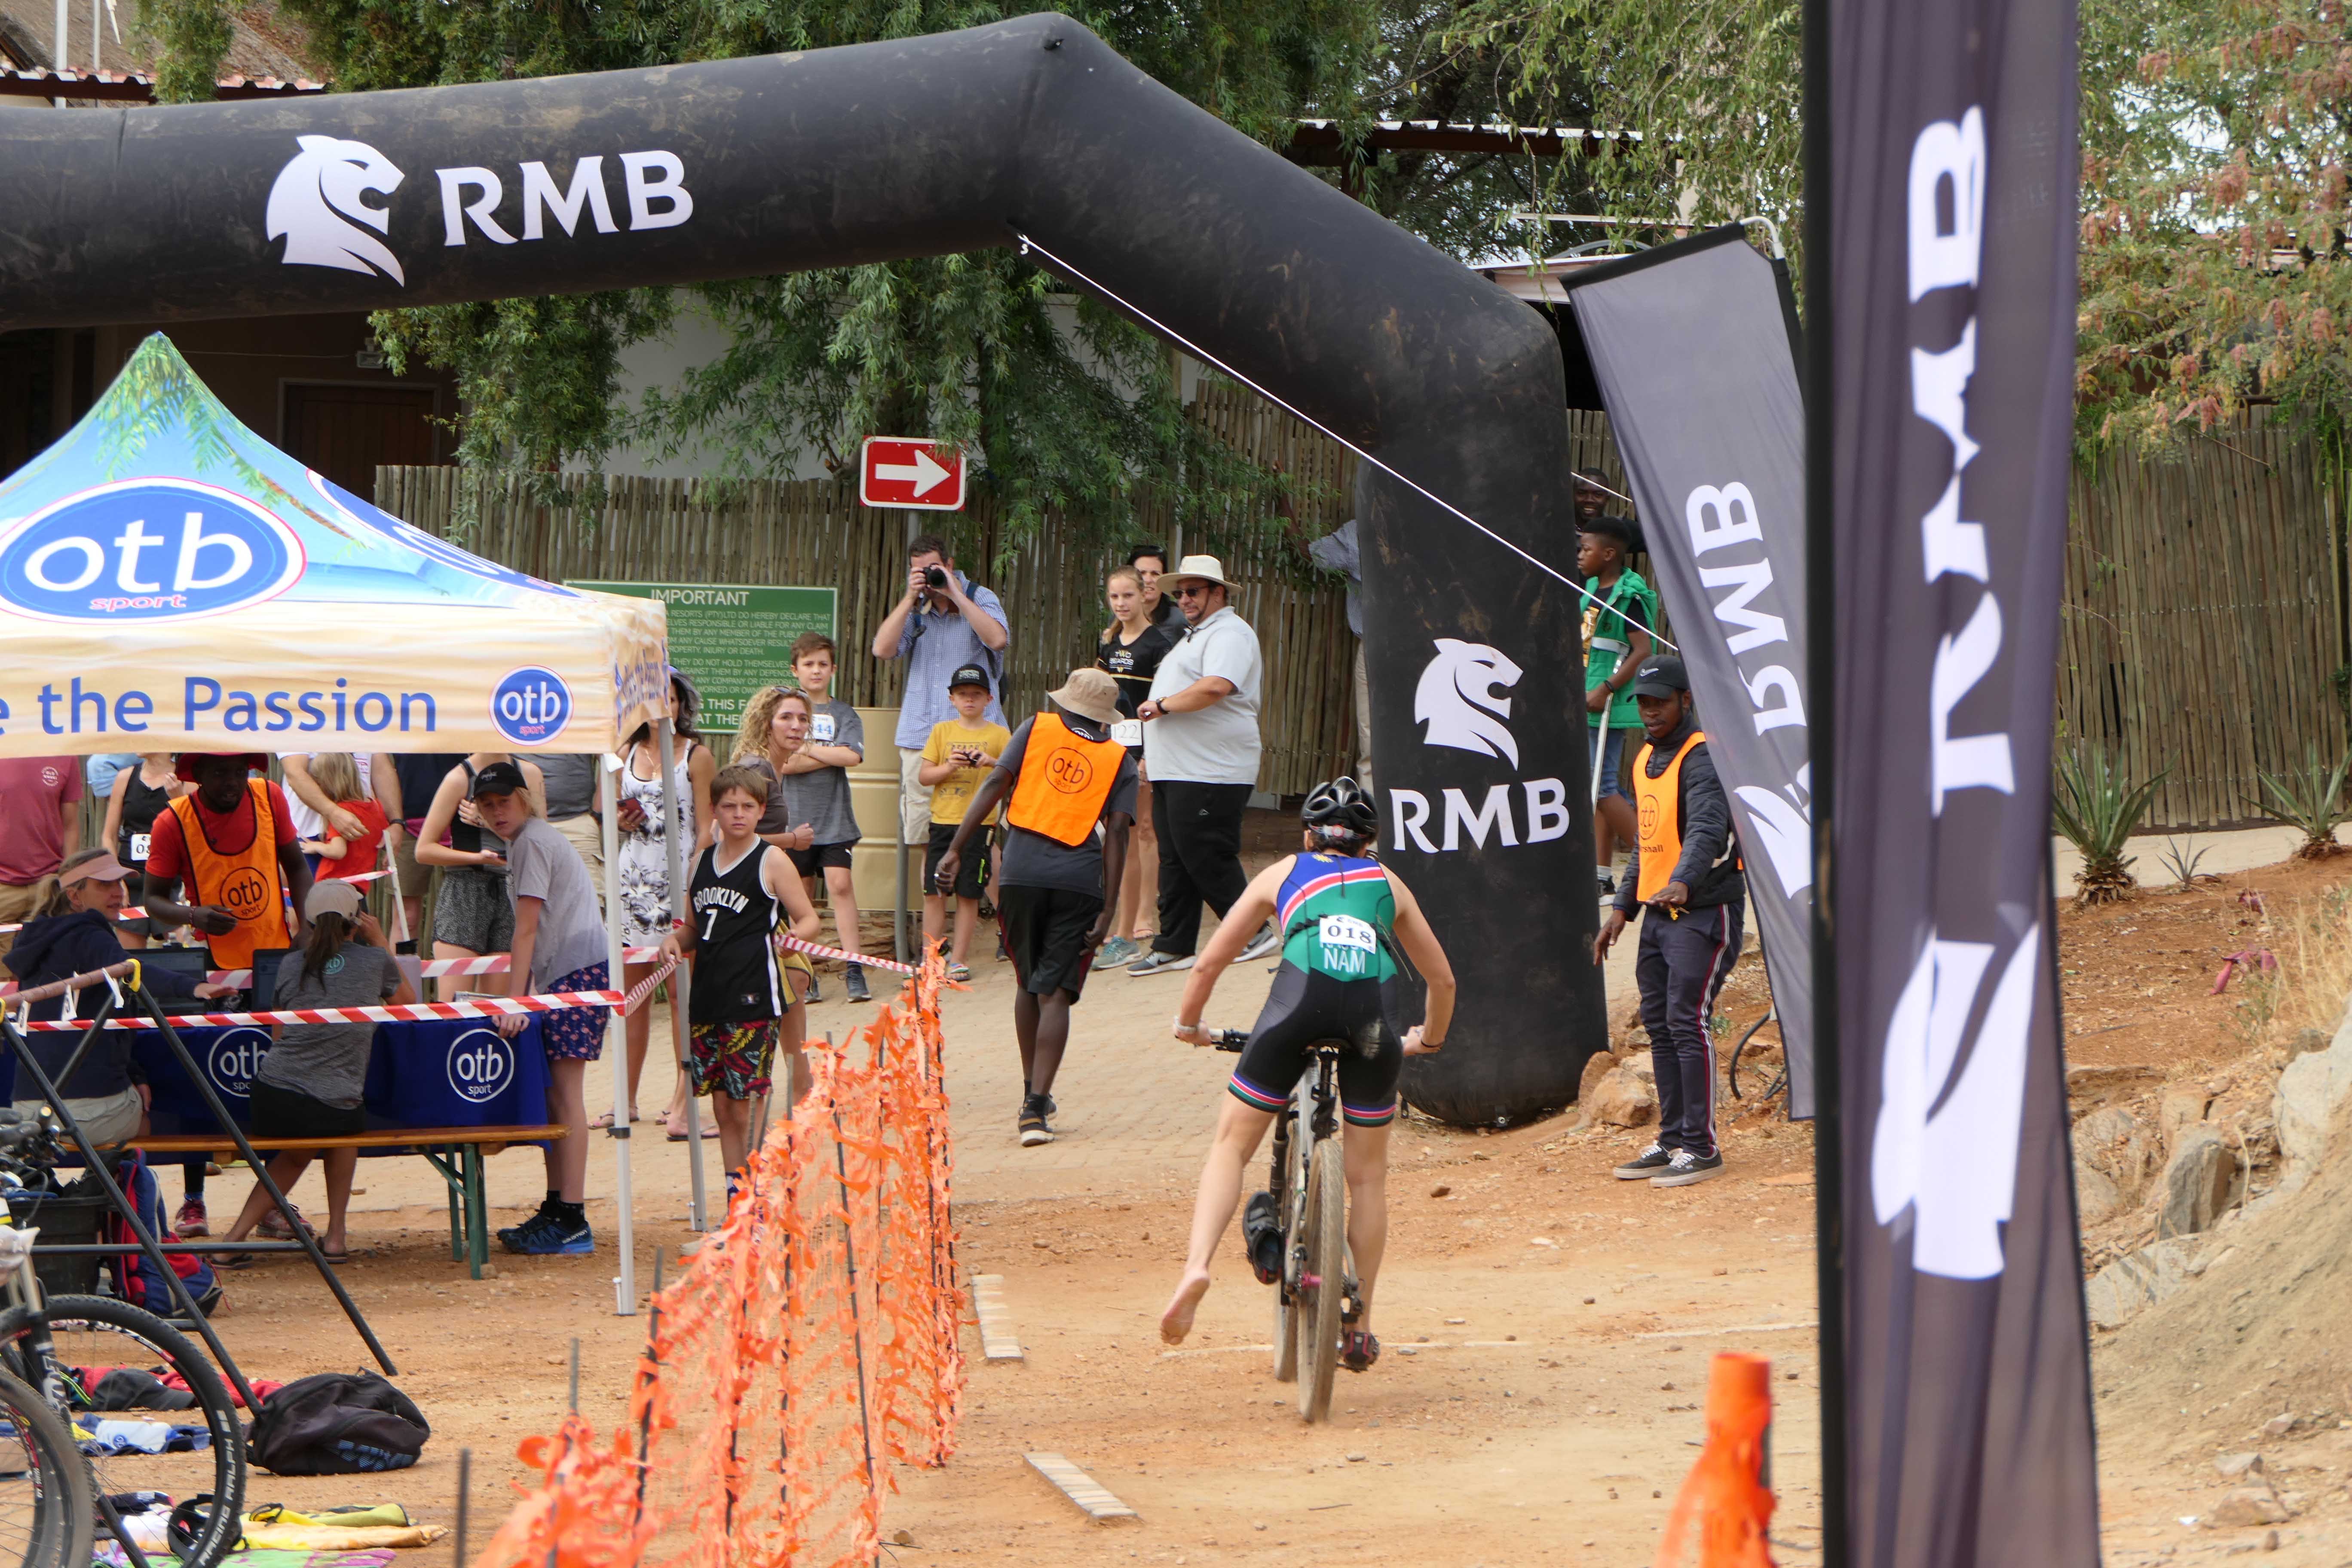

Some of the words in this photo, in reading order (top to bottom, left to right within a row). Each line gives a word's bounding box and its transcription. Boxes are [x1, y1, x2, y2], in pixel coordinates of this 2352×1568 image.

[435, 150, 693, 246] RMB
[24, 512, 253, 593] otb
[89, 594, 187, 612] sport
[650, 589, 750, 606] IMPORTANT
[671, 609, 703, 618] RESORTS
[719, 638, 766, 646] WHATSOEVER
[744, 660, 789, 668] THEMSELVES
[37, 677, 154, 735] the
[184, 677, 436, 732] Passion
[500, 681, 560, 724] otb
[707, 698, 735, 710] THIS
[519, 725, 545, 736] sport
[814, 723, 832, 735] 44
[1053, 757, 1084, 784] otb
[1389, 777, 1570, 854] RMB
[227, 876, 262, 907] otb
[693, 886, 750, 914] BROOKLYN
[701, 908, 718, 941] 7
[1327, 925, 1372, 944] 018
[1324, 947, 1366, 975] NAM
[456, 1044, 503, 1083] otb
[467, 1084, 492, 1097] sport
[224, 1438, 236, 1501] RALPH
[199, 1504, 231, 1567] RACING
